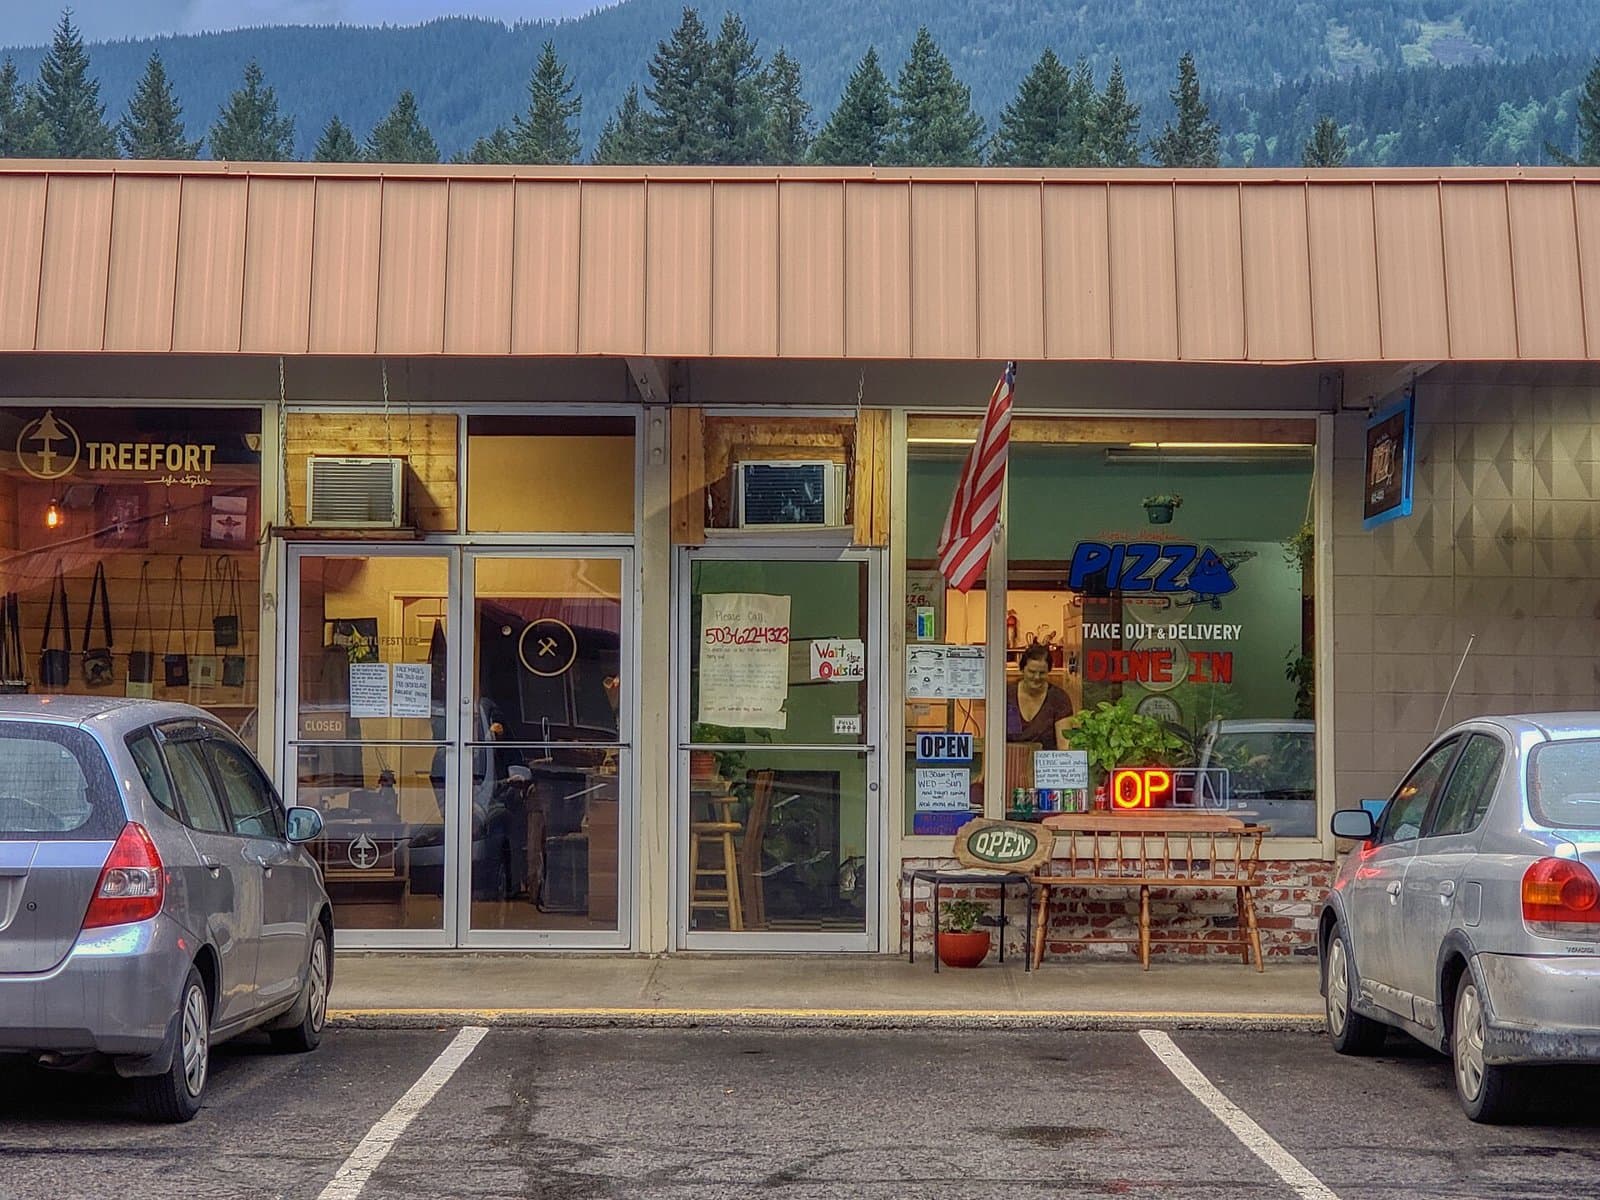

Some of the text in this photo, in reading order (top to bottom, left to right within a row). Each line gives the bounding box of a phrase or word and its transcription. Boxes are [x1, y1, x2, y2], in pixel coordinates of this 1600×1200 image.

[86, 442, 216, 472] TREEFORT
[1082, 623, 1242, 640] TAKE OUT & DELIVERY
[814, 642, 847, 659] Wait
[818, 660, 864, 680] Outside
[1087, 651, 1173, 683] DINE
[1188, 651, 1233, 683] IN
[305, 720, 342, 731] CLOSED
[921, 736, 969, 758] OPEN
[917, 779, 937, 788] WED
[1114, 770, 1224, 808] OPEN
[975, 831, 1031, 857] OPEN
